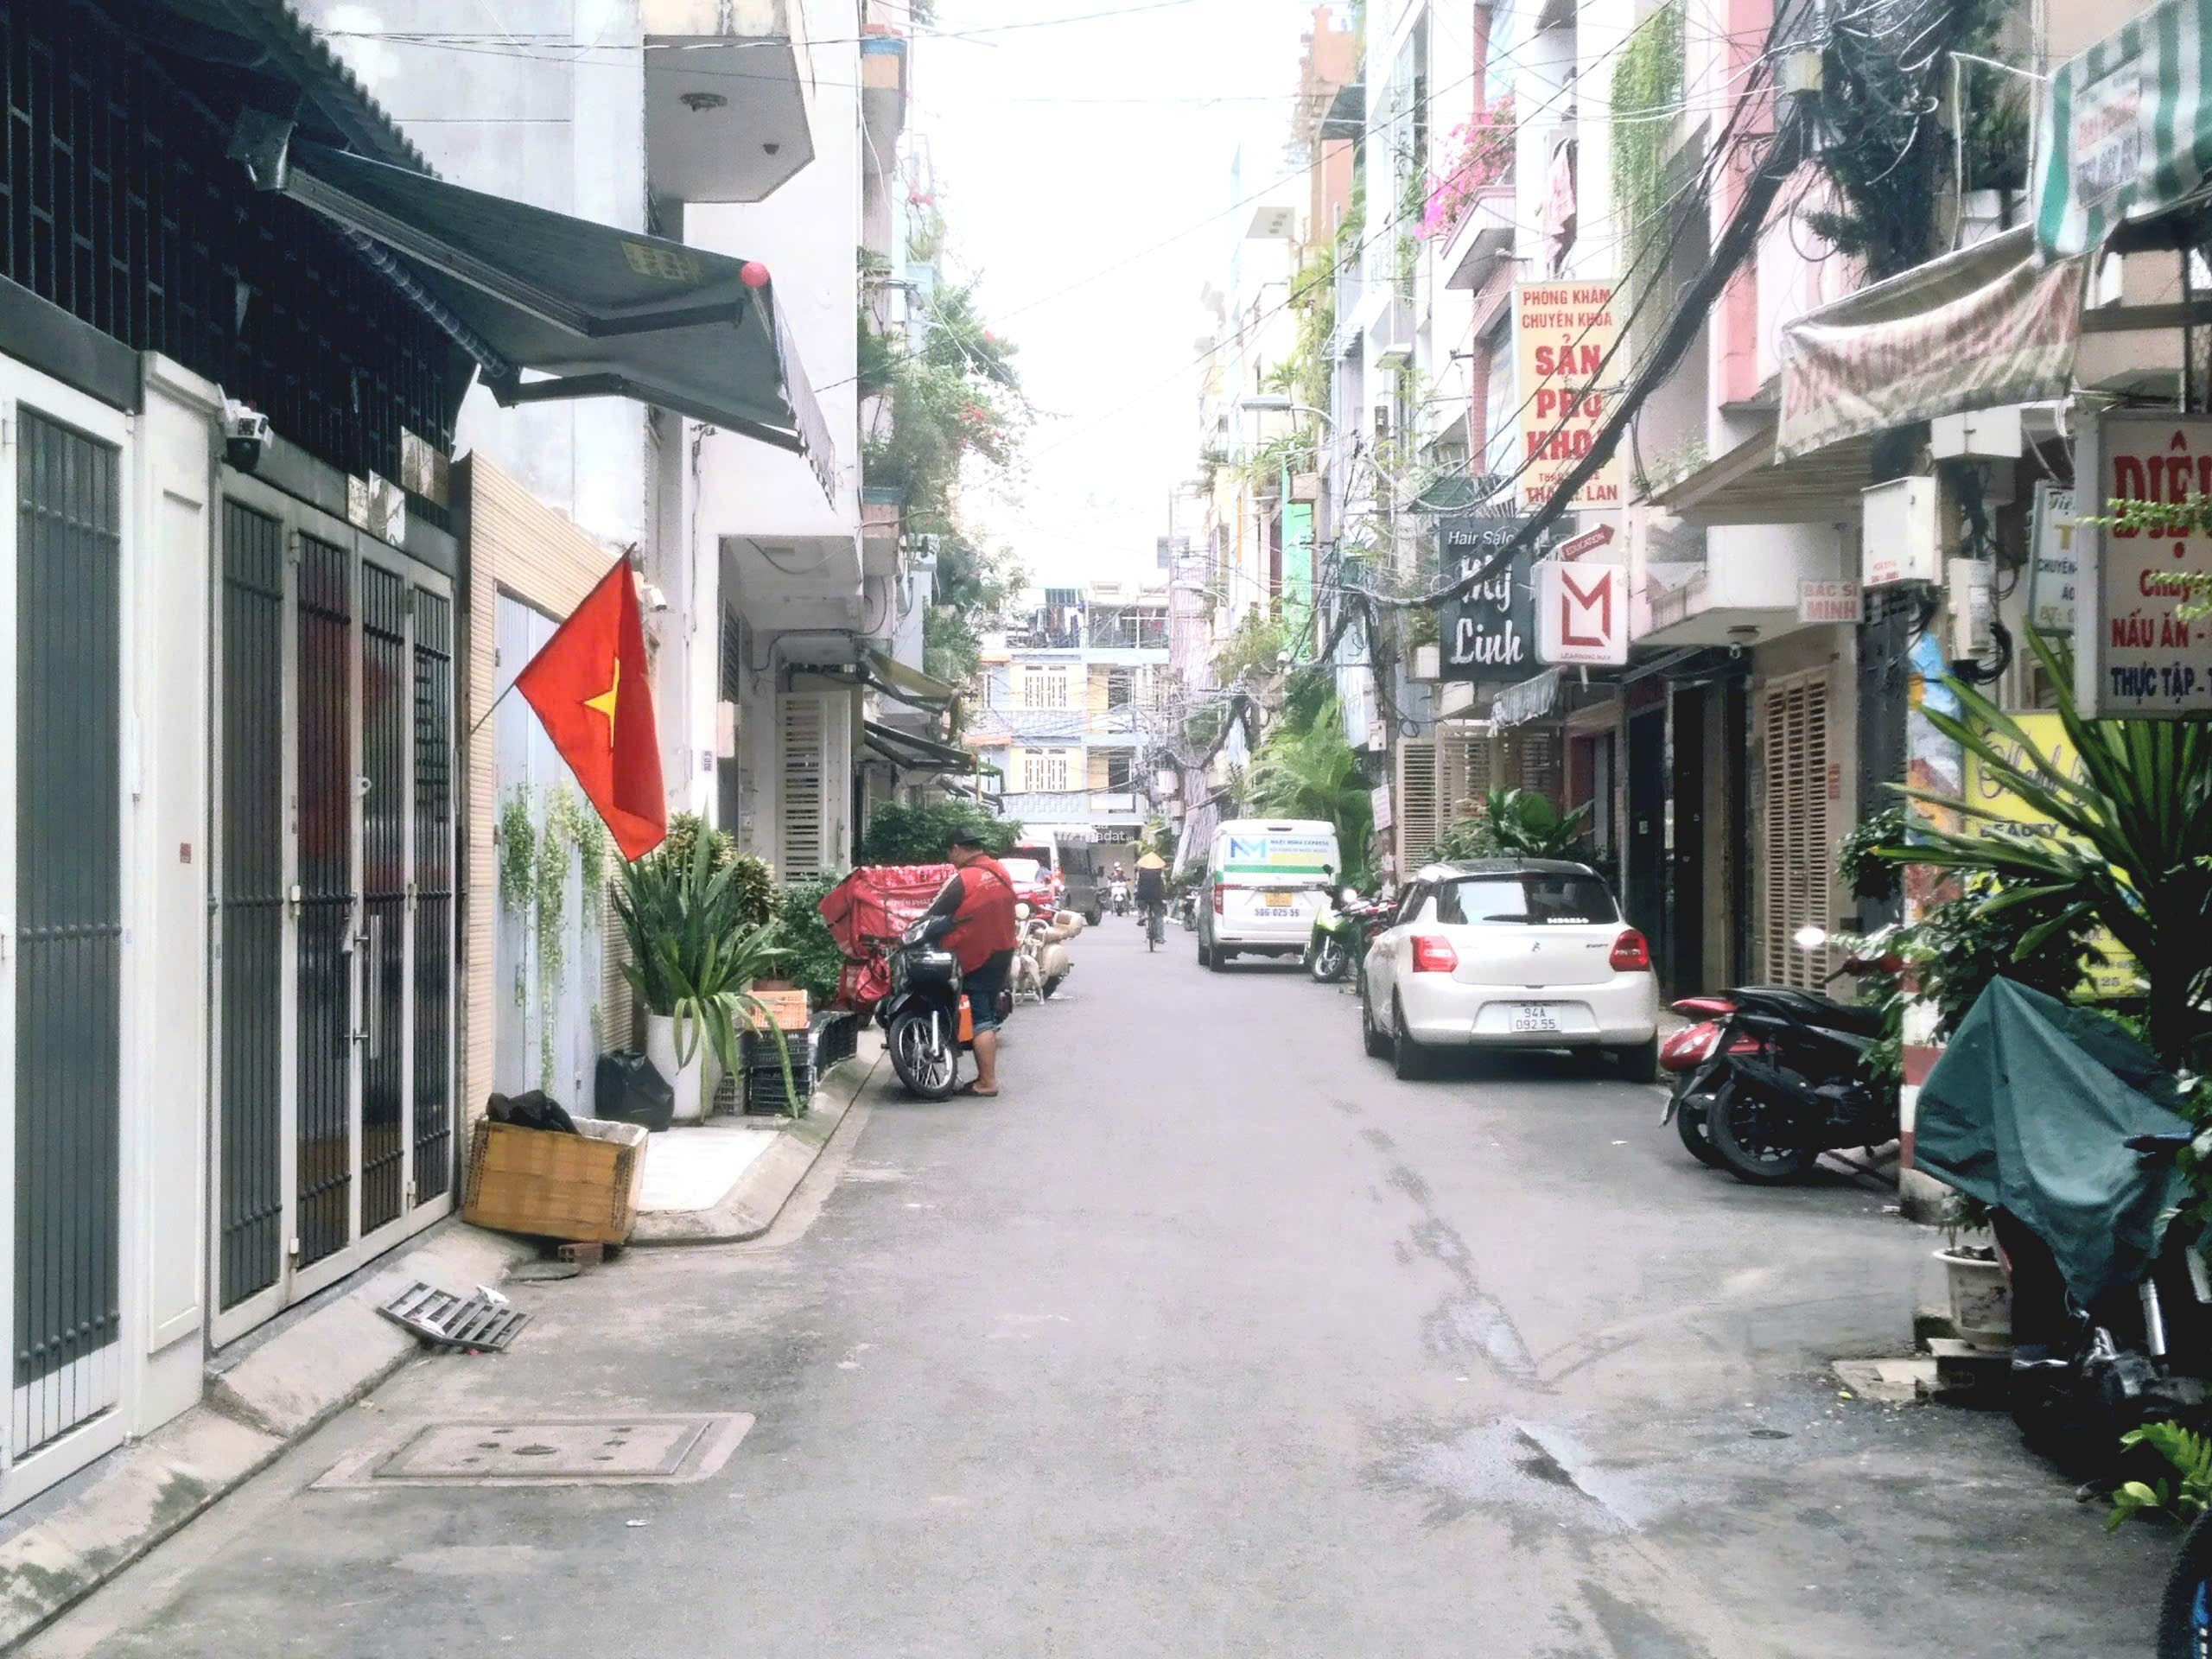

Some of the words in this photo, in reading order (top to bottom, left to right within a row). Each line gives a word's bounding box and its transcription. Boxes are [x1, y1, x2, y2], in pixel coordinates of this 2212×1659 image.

[1523, 287, 1567, 305] PHÒNG
[1522, 310, 1573, 328] CHUYÊN
[1578, 312, 1612, 327] KHOA
[1535, 334, 1600, 376] SẢN
[1586, 485, 1618, 501] LAN
[1447, 531, 1478, 545] Hair
[2112, 607, 2154, 648] NẤU
[2160, 611, 2190, 648] ĂN
[1450, 618, 1524, 664] Linh
[2111, 659, 2157, 705] THỰC
[2161, 661, 2196, 704] TẬP
[1524, 1007, 1547, 1019] 94A
